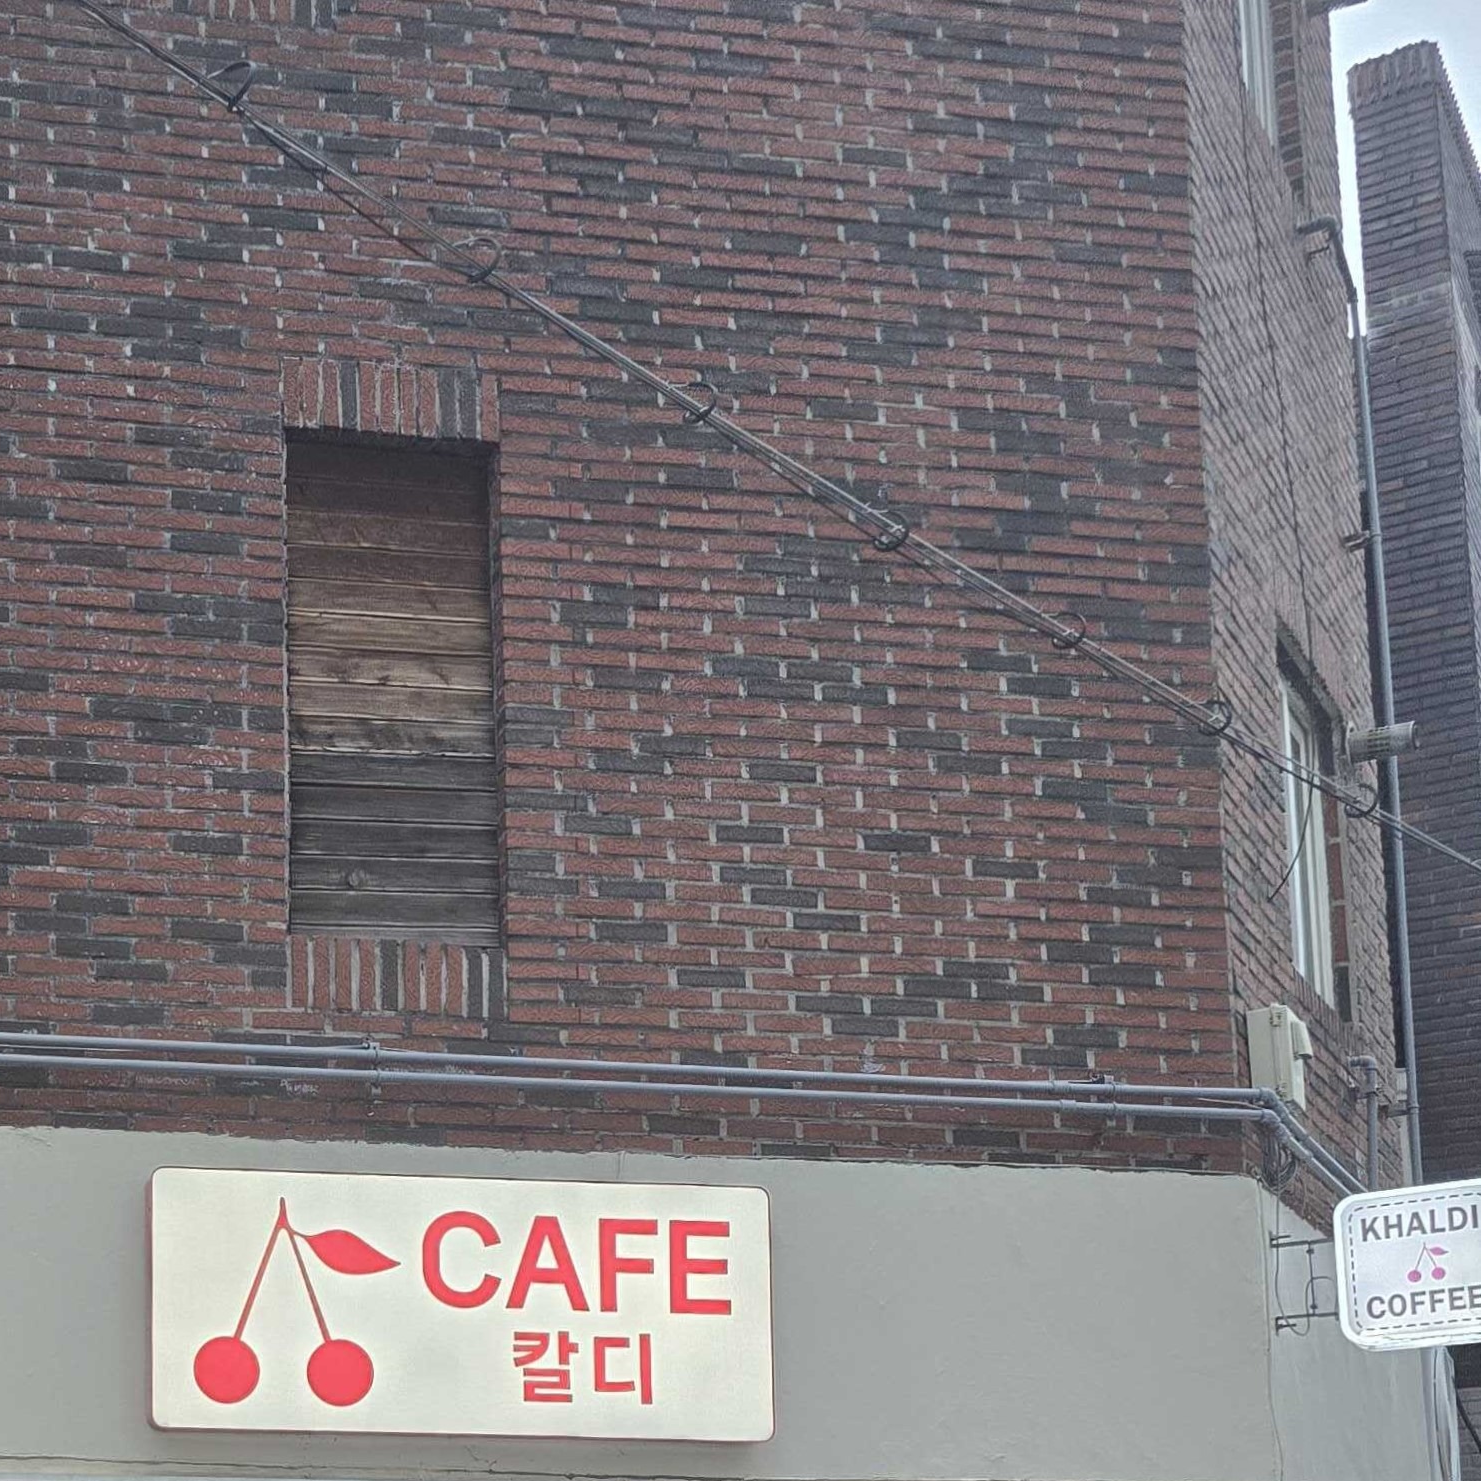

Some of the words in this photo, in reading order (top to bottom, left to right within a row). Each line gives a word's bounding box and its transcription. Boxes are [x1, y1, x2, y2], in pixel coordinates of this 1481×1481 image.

[1360, 1204, 1480, 1242] KHALDI
[422, 1210, 732, 1315] CAFE
[1366, 1285, 1481, 1320] COFFEE
[512, 1330, 653, 1405] 칼디
